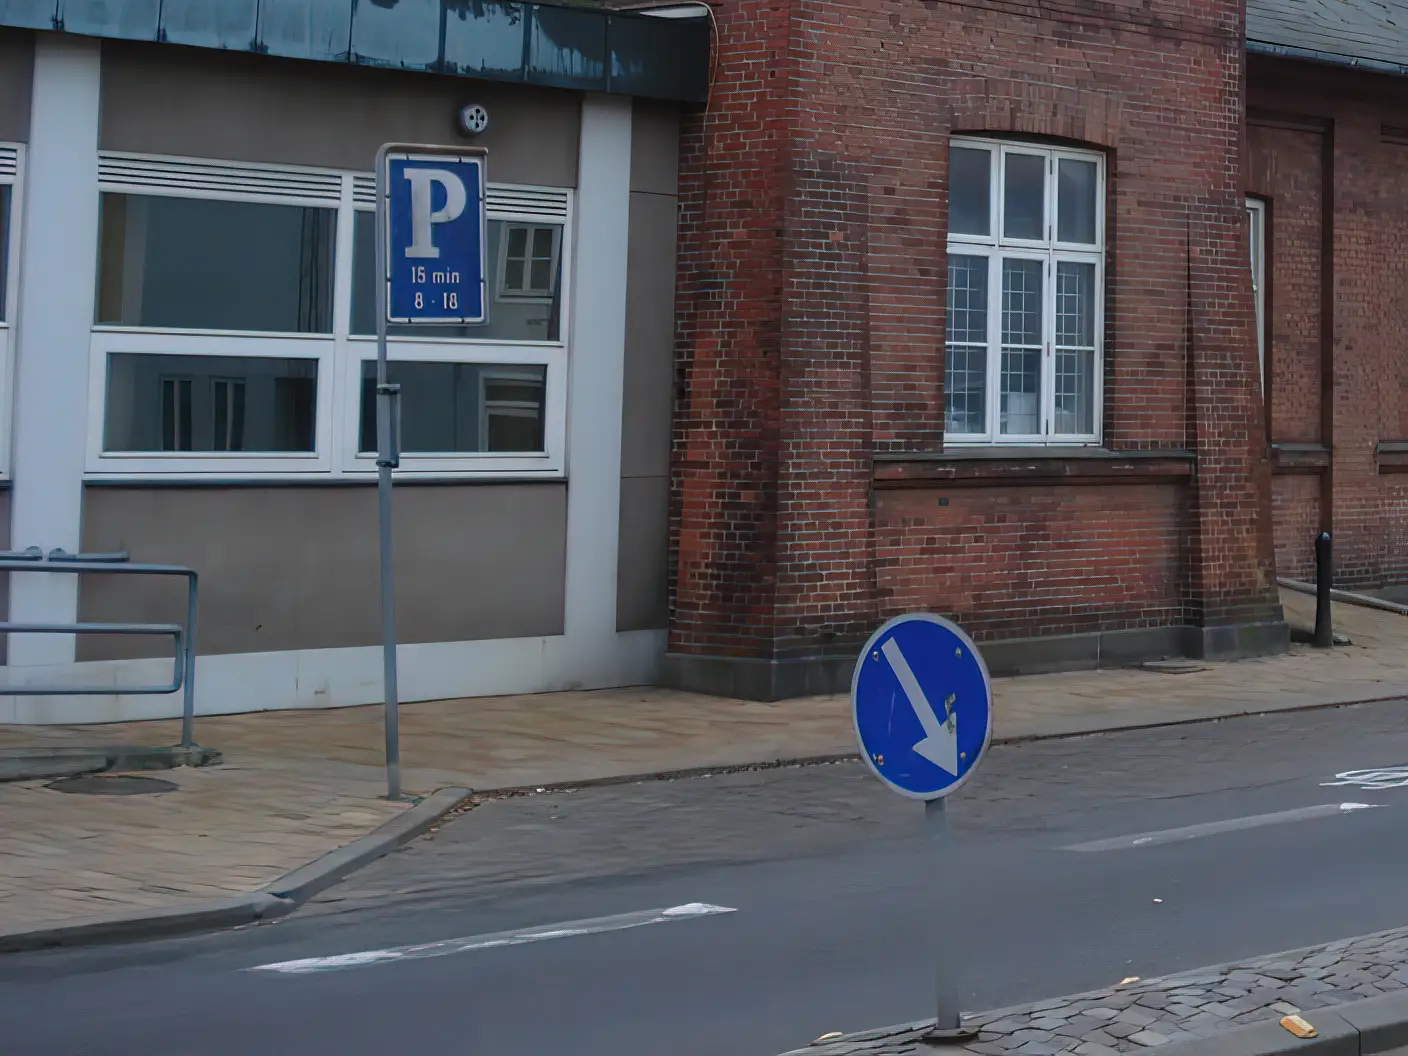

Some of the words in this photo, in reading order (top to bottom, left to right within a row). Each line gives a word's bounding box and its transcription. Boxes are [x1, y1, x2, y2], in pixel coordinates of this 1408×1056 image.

[403, 167, 467, 259] P
[432, 266, 460, 284] min
[414, 291, 424, 310] 8
[443, 291, 458, 310] 18
